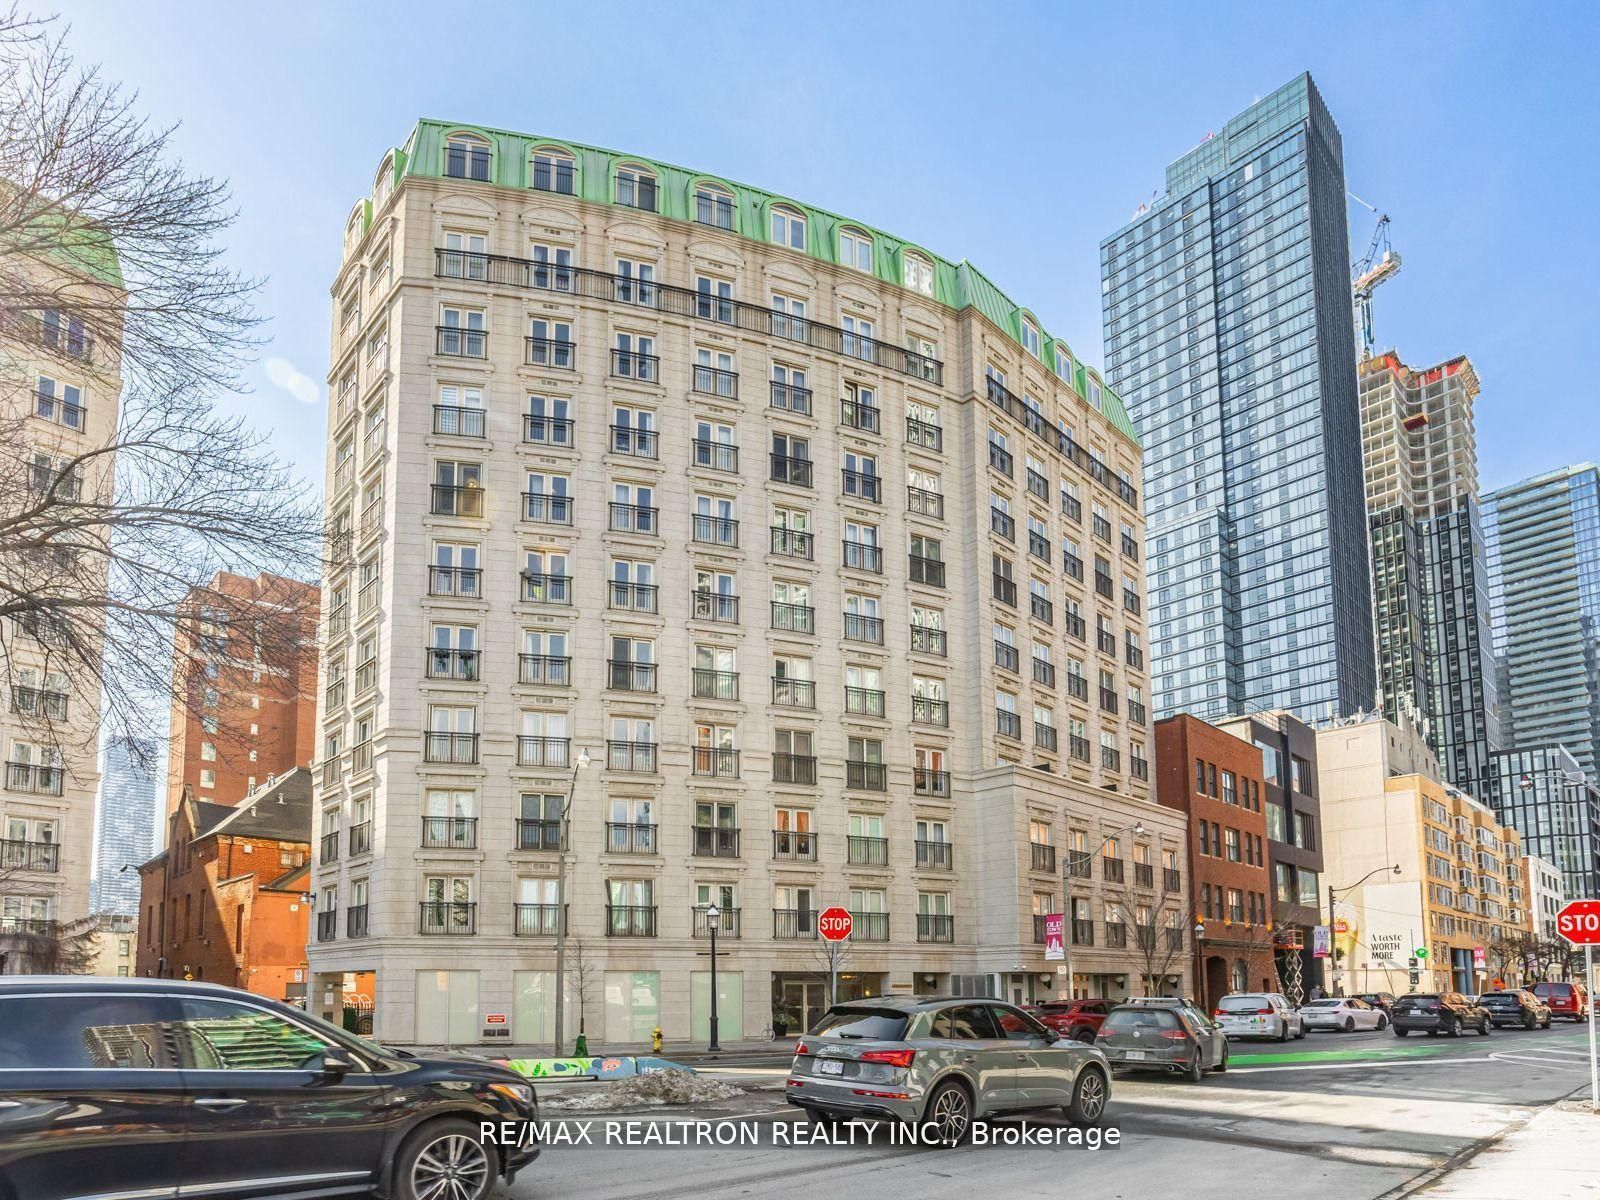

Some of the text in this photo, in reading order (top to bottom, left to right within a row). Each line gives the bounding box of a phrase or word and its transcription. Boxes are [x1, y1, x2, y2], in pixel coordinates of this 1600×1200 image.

[821, 917, 851, 931] STOP
[1371, 942, 1400, 951] WORTH
[1371, 951, 1394, 960] MORE
